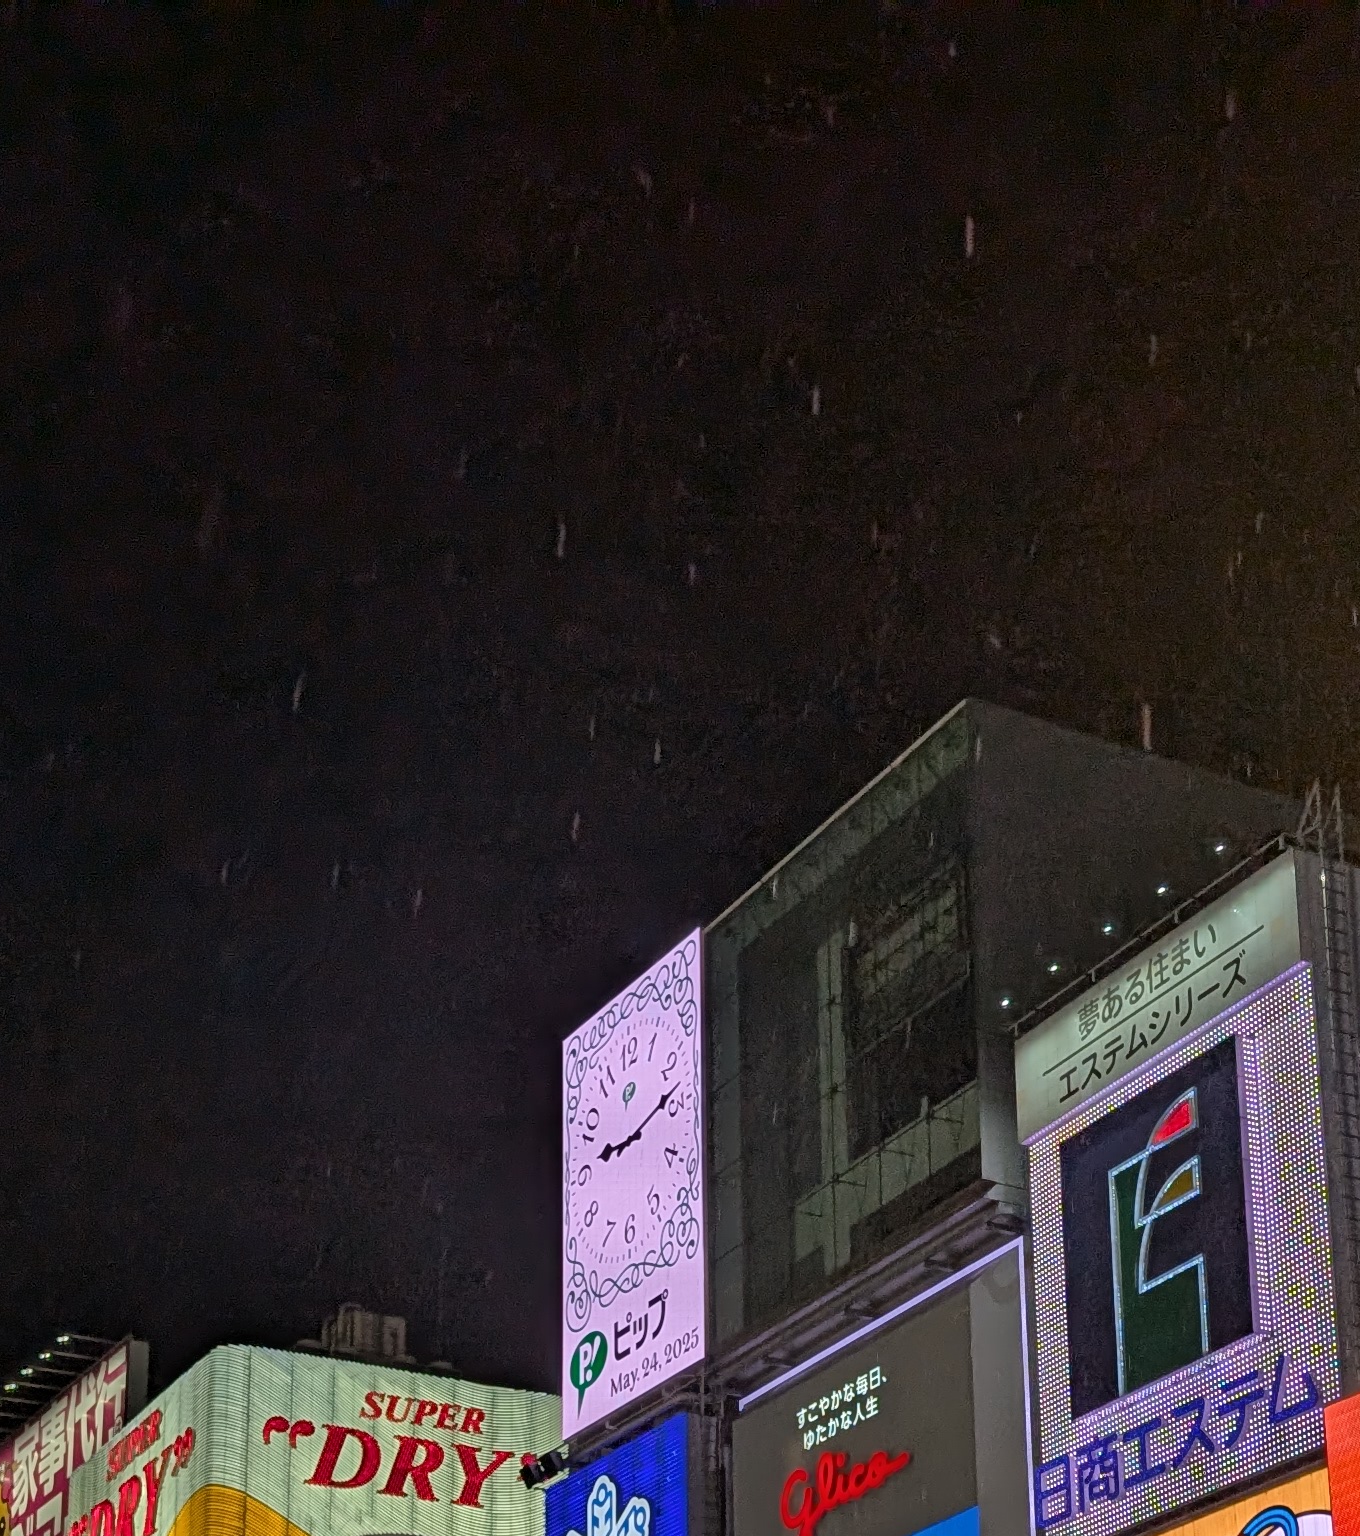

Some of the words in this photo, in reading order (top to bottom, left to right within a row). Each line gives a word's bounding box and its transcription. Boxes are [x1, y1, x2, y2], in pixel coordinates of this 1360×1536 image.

[1076, 924, 1217, 1041] 夢ある住まい
[1058, 949, 1247, 1104] エステムシリーズ
[620, 1036, 638, 1072] 12
[647, 1032, 658, 1062] 1
[599, 1065, 616, 1098] 11
[660, 1051, 678, 1082] 2
[668, 1091, 685, 1118] 3
[582, 1107, 600, 1146] 10
[663, 1143, 679, 1169] 4
[577, 1164, 592, 1187] 9
[583, 1200, 599, 1228] 8
[646, 1184, 661, 1216] 5
[601, 1219, 617, 1248] 7
[623, 1213, 636, 1244] 6
[613, 1289, 669, 1362] ピップ
[610, 1367, 640, 1398] May.
[642, 1352, 662, 1379] 24,
[664, 1326, 699, 1365] 2025
[360, 1391, 486, 1434] SUPER
[795, 1366, 887, 1430] すこやかな毎日、
[9, 1348, 128, 1513] 家事代行
[803, 1396, 879, 1451] ゆたかな人生
[1034, 1355, 1319, 1529] 日商エステム
